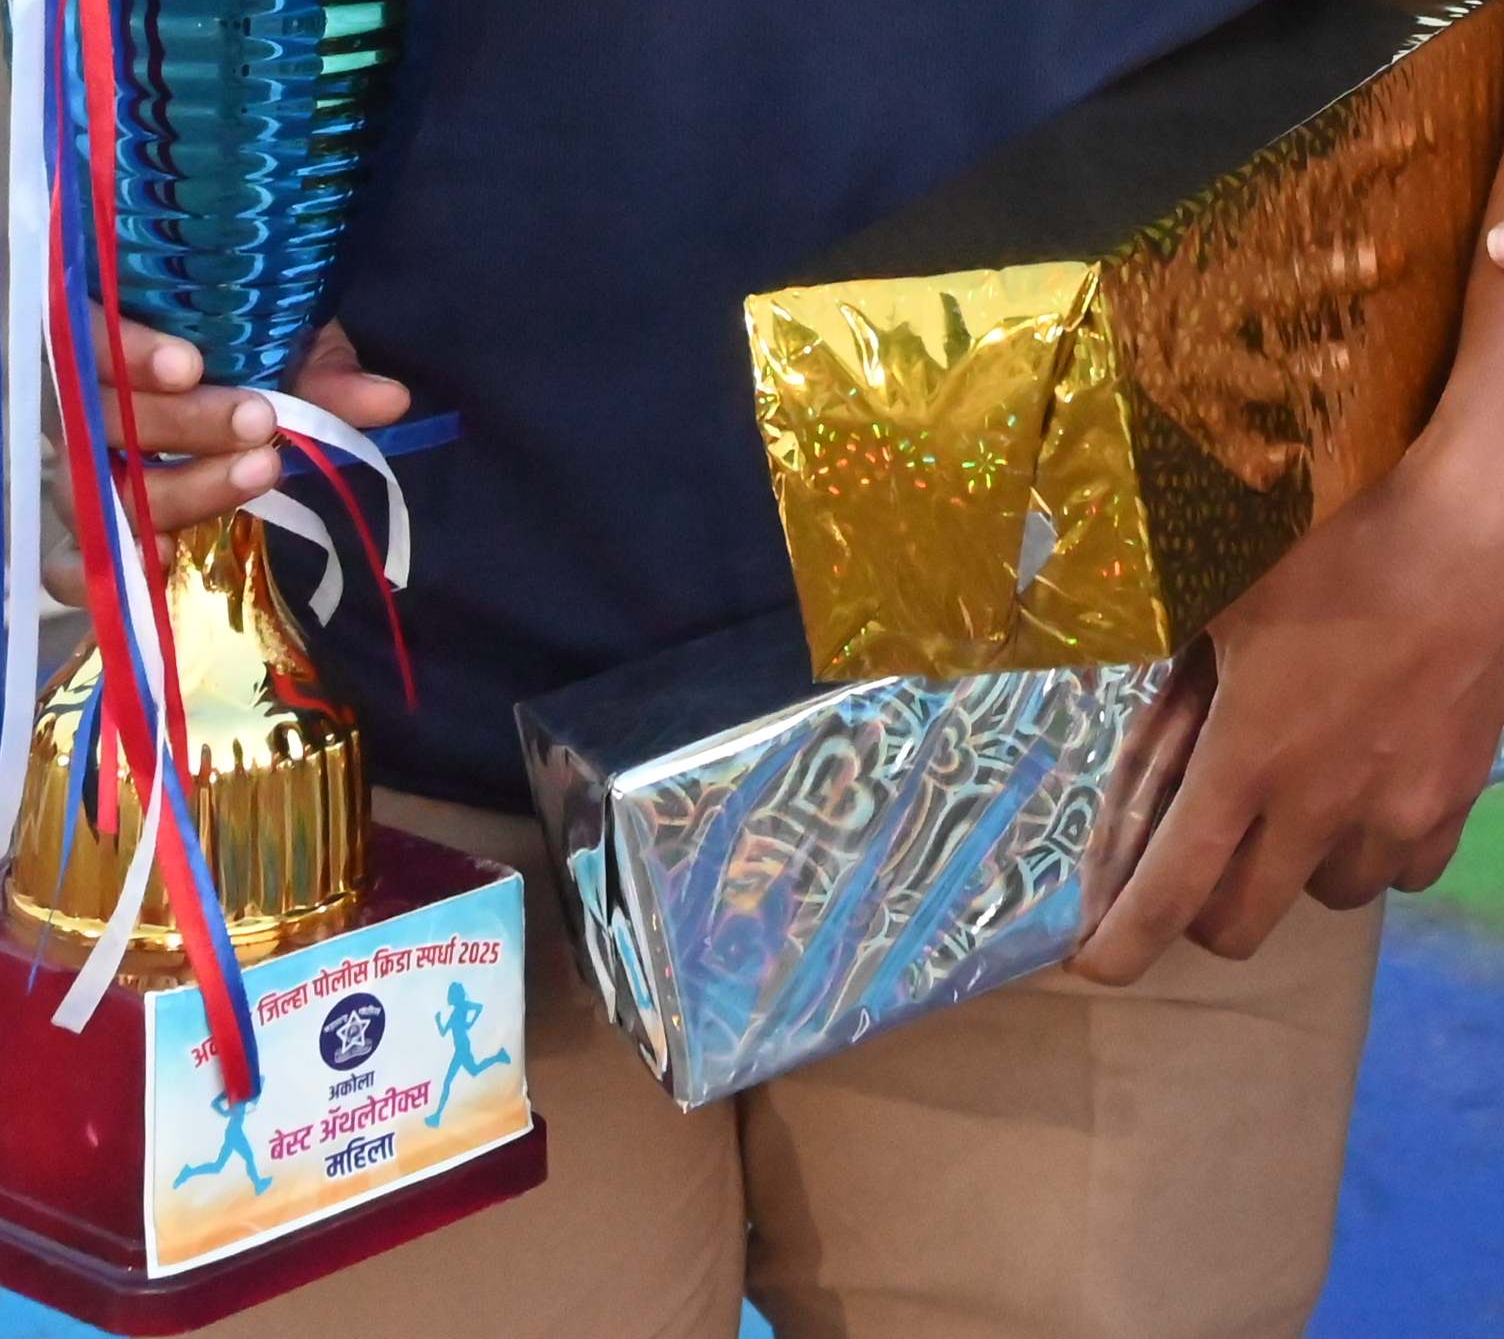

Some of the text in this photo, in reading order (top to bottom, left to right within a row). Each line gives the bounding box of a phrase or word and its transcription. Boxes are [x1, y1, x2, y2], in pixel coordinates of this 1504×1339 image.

[257, 983, 309, 1027] जिल्हा
[312, 959, 369, 998] पोलीस
[373, 948, 413, 979] क्रिडा
[416, 935, 457, 968] स्पर्धा
[458, 941, 501, 965] 2025
[328, 1070, 375, 1101] अकोला
[269, 1124, 314, 1160] बेस्ट
[324, 1131, 395, 1178] महिला
